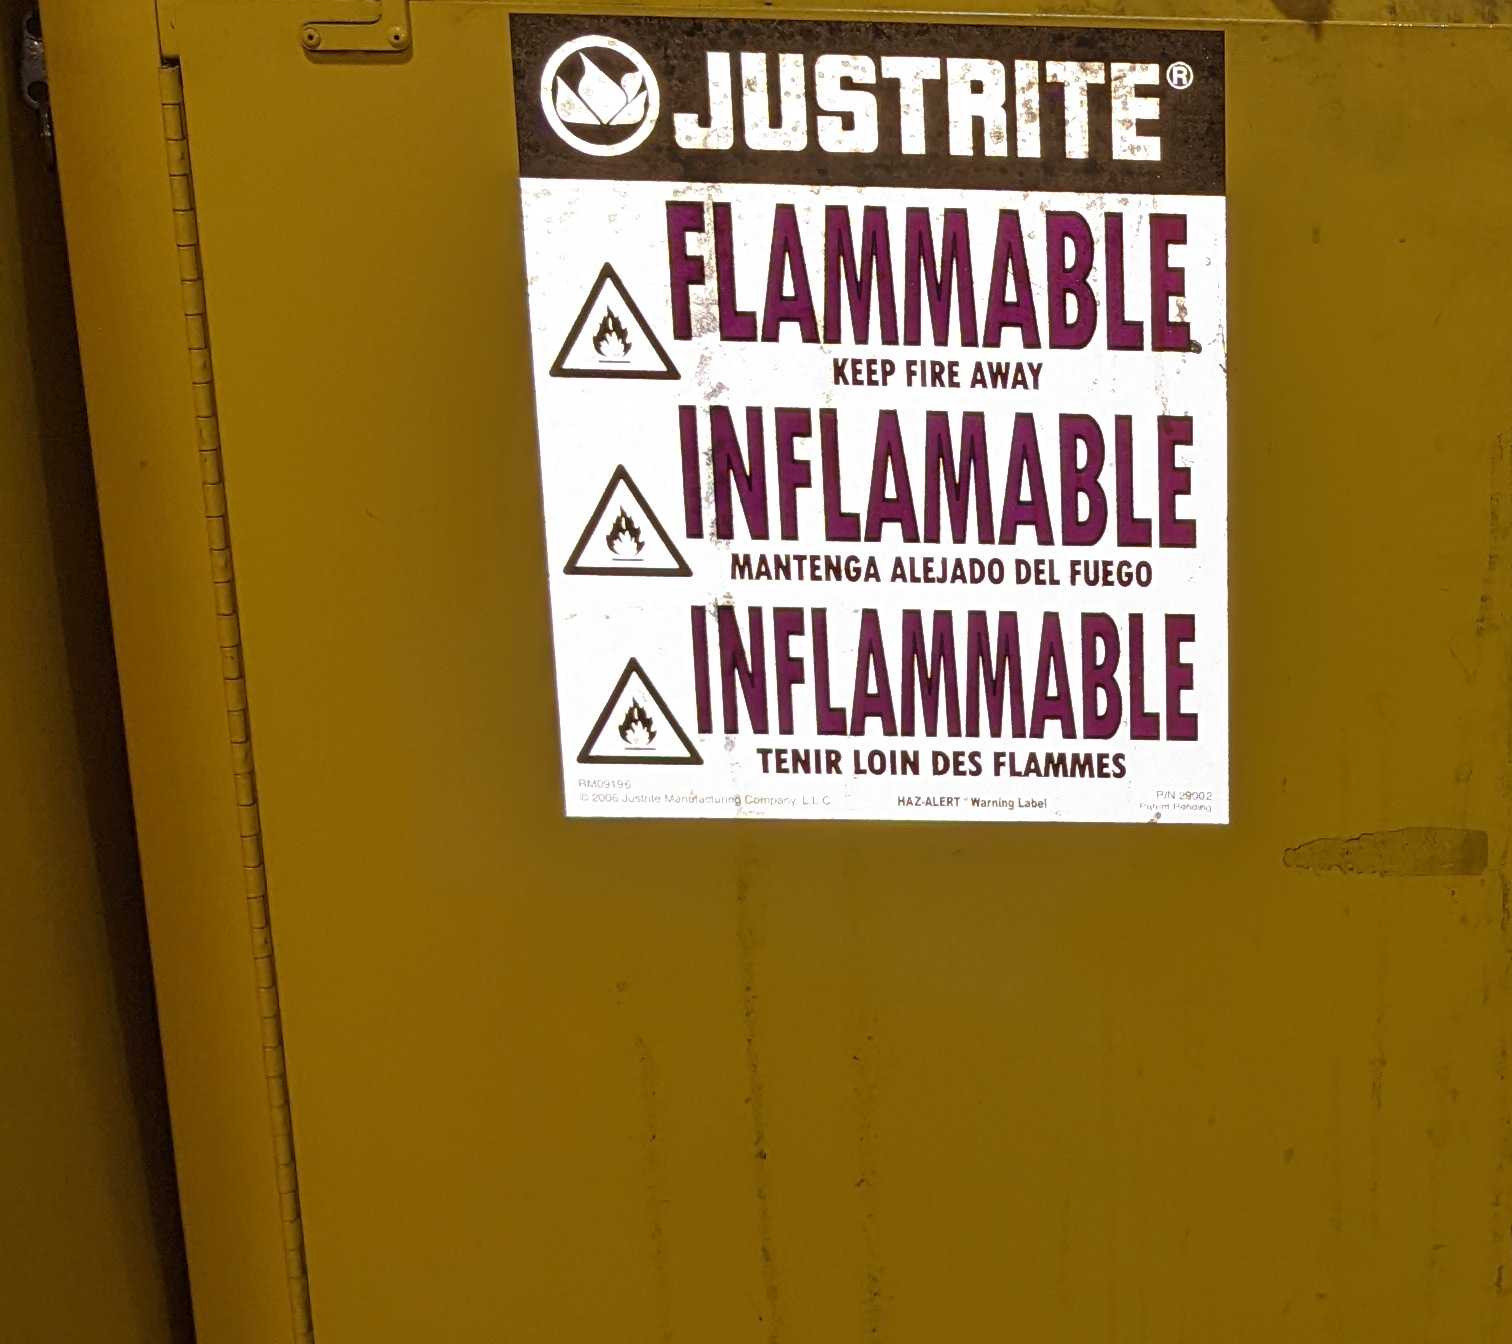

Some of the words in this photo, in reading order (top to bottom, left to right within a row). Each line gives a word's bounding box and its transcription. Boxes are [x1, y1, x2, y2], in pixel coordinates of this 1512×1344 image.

[665, 199, 1193, 354] FLAMMABLE
[832, 357, 897, 388] KEEP
[905, 358, 962, 389] FIRE
[969, 360, 1044, 391] AWAY
[677, 404, 1198, 549] INFLAMABLE
[729, 553, 883, 584] MANTENGA
[889, 555, 1006, 586] ALEJADO
[1014, 558, 1062, 587] DEL
[1068, 559, 1155, 589] FUEGO
[689, 604, 1200, 742] INFLAMMABLE
[756, 747, 844, 776] TENIR
[852, 748, 922, 778] LOIN
[931, 750, 984, 779] DES
[992, 750, 1129, 780] FLAMMES
[896, 794, 962, 807] HAZ-ALERT
[970, 797, 1016, 811] Warning
[1017, 797, 1048, 810] Label
